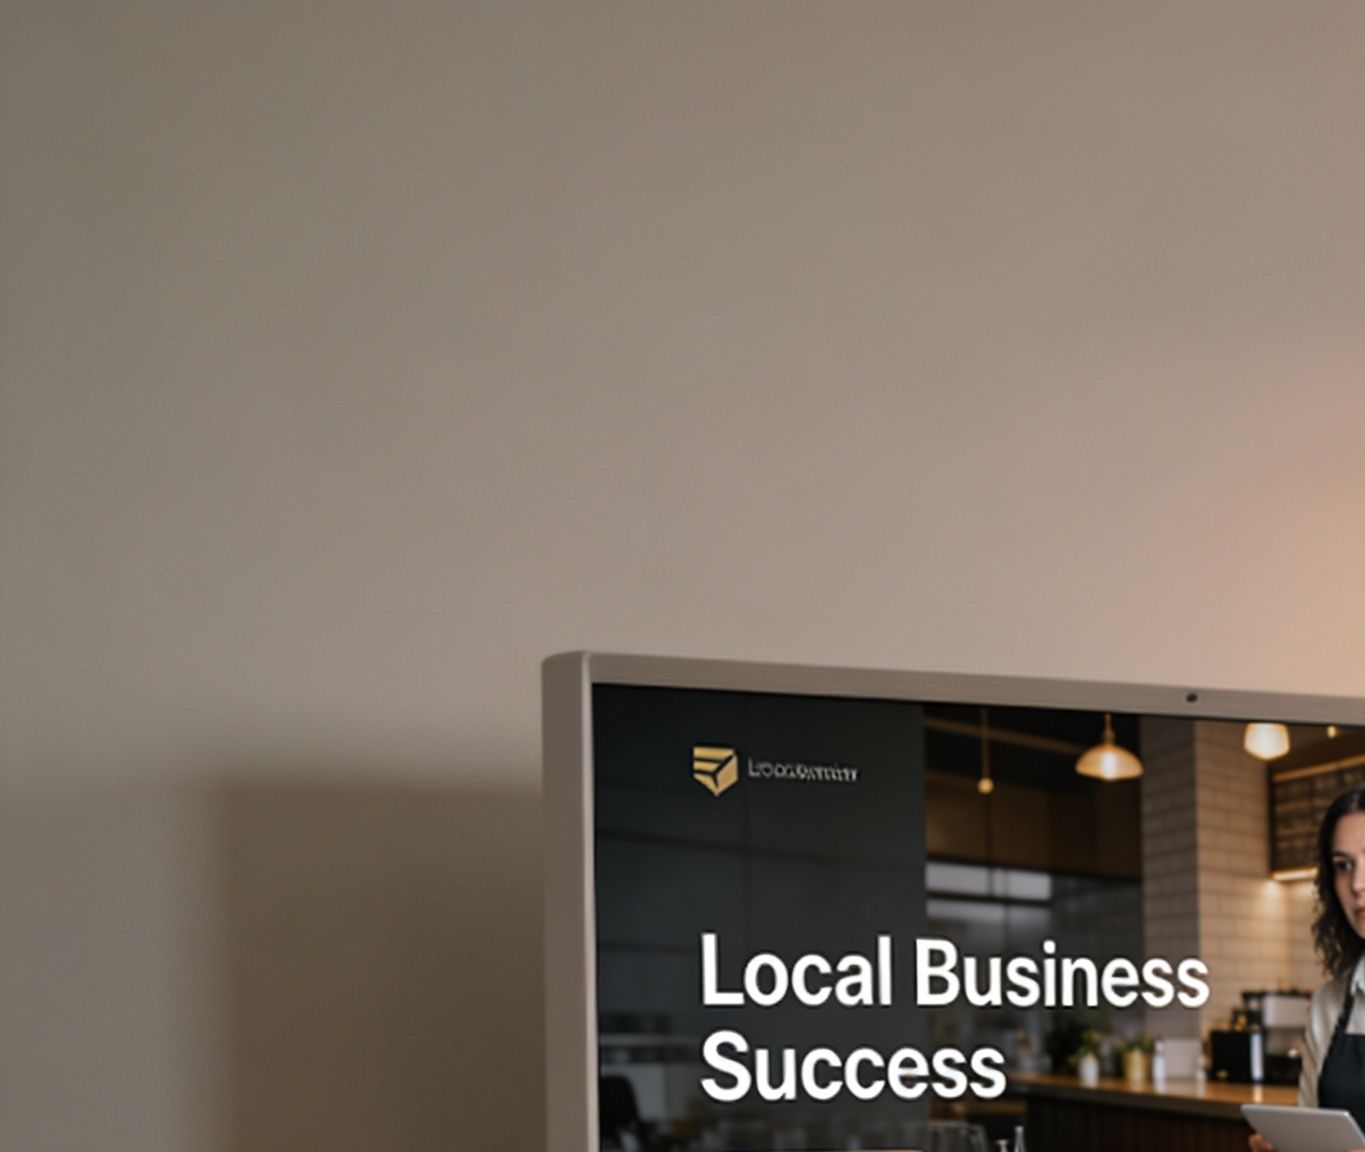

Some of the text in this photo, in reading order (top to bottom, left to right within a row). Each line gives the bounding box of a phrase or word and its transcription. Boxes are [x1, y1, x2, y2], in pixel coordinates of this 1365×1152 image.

[702, 933, 1211, 1008] Local Business
[701, 1030, 1006, 1101] Success
